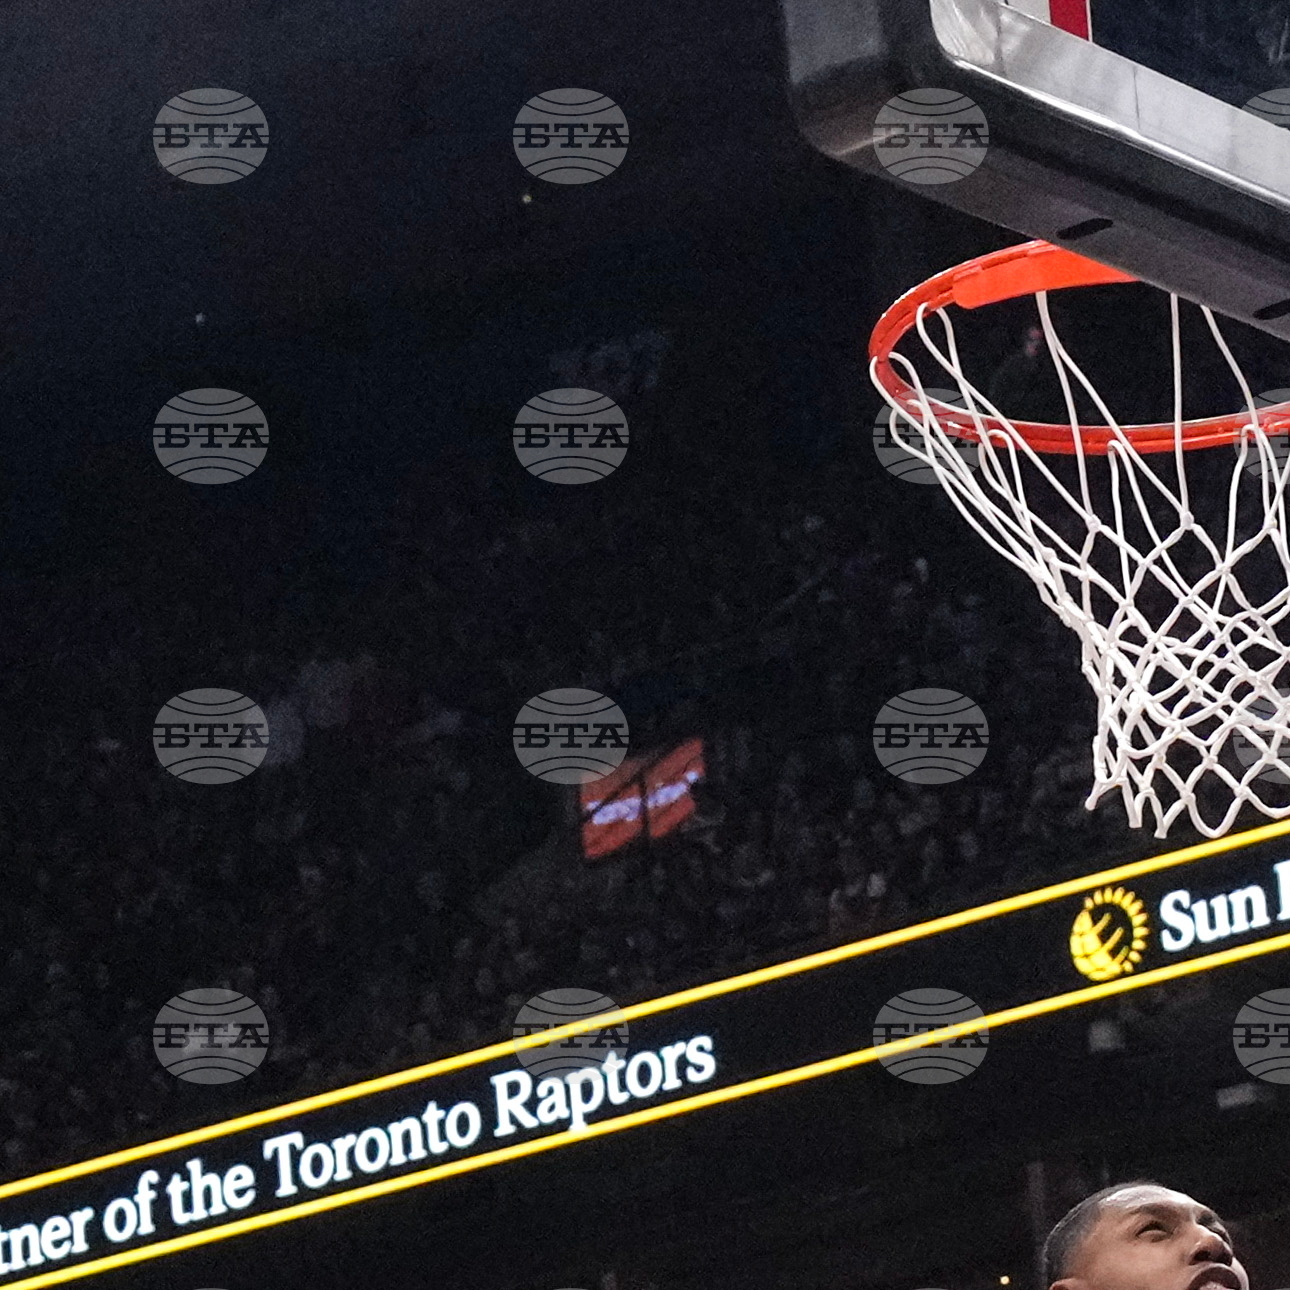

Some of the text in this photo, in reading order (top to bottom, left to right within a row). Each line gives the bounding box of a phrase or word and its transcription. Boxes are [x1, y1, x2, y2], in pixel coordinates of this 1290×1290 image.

[1159, 885, 1271, 951] Sun
[102, 1170, 161, 1242] of
[165, 1158, 257, 1225] the
[262, 1101, 482, 1198] Toronto
[490, 1035, 717, 1138] Raptors
